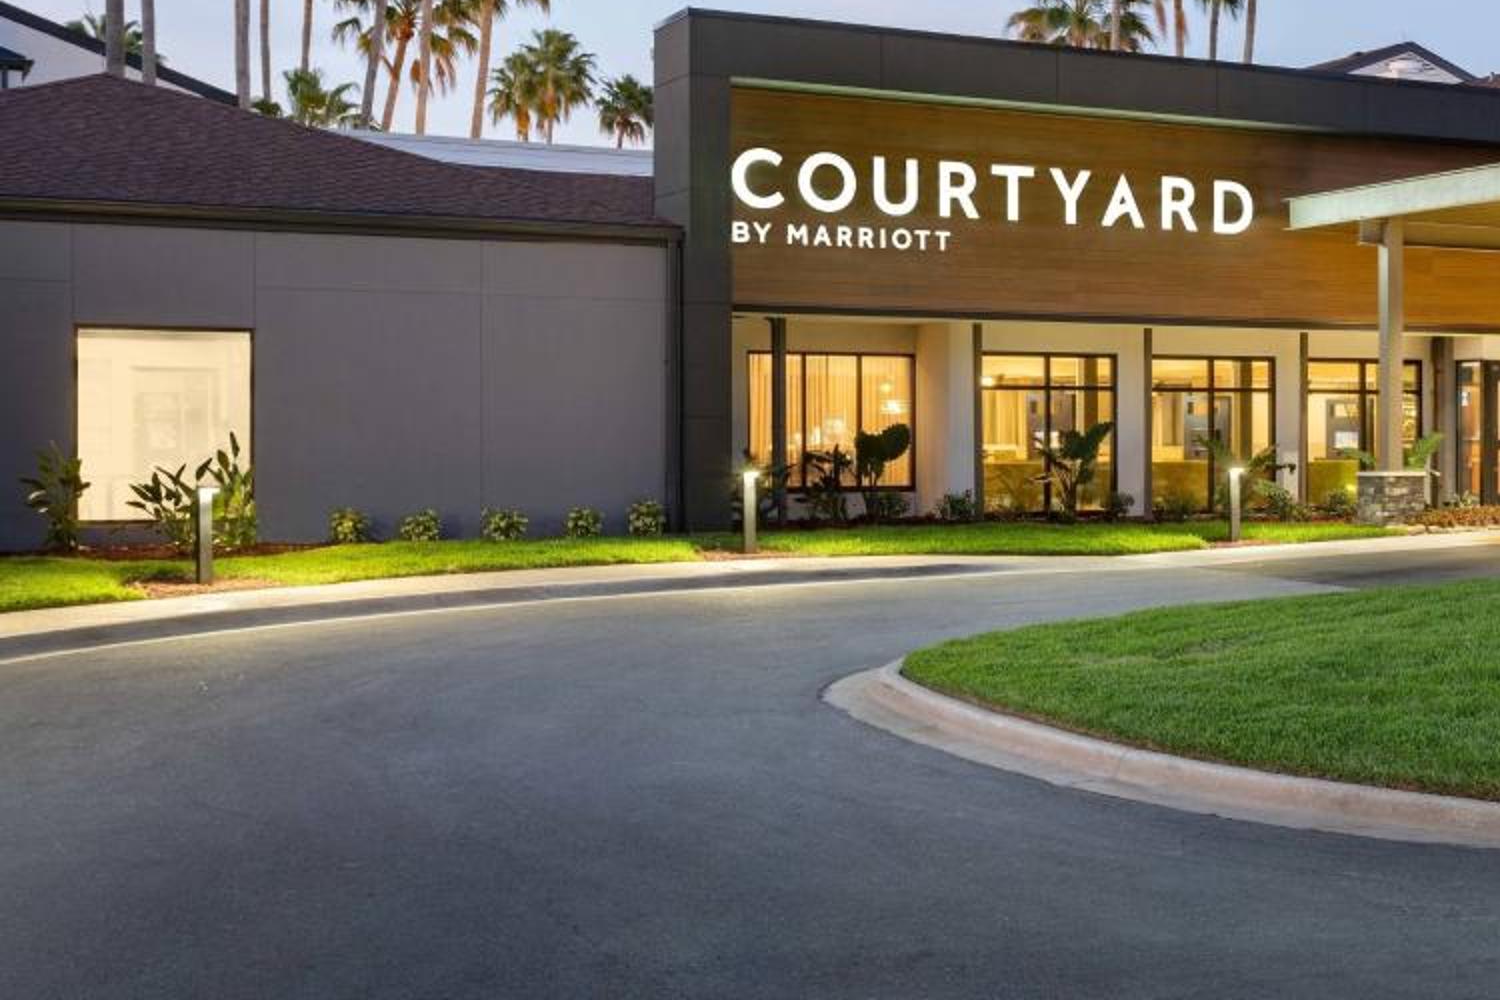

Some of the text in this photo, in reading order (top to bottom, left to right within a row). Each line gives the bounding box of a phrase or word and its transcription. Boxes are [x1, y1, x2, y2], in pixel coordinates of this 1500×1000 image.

[731, 147, 1254, 235] COURTYARD
[731, 220, 951, 251] BY MARRIOTT
